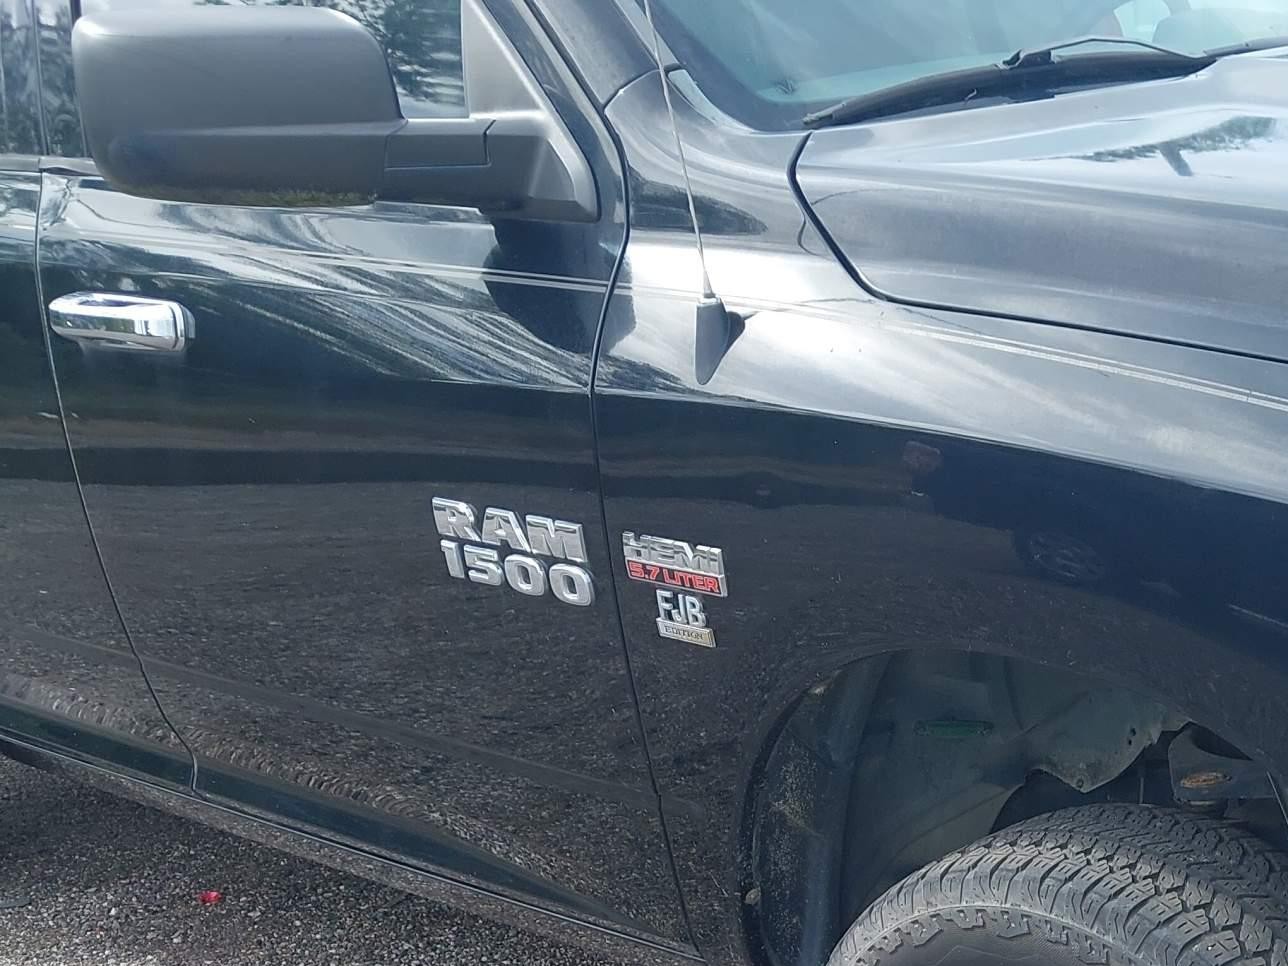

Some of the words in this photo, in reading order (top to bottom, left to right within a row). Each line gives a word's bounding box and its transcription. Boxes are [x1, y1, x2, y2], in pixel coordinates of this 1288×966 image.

[432, 496, 588, 563] RAM
[440, 539, 595, 607] 1500
[622, 531, 724, 574] HEMI
[629, 561, 660, 580] 5.7
[664, 567, 722, 594] LITER
[655, 588, 707, 627] FJB
[663, 625, 705, 640] EDITION
